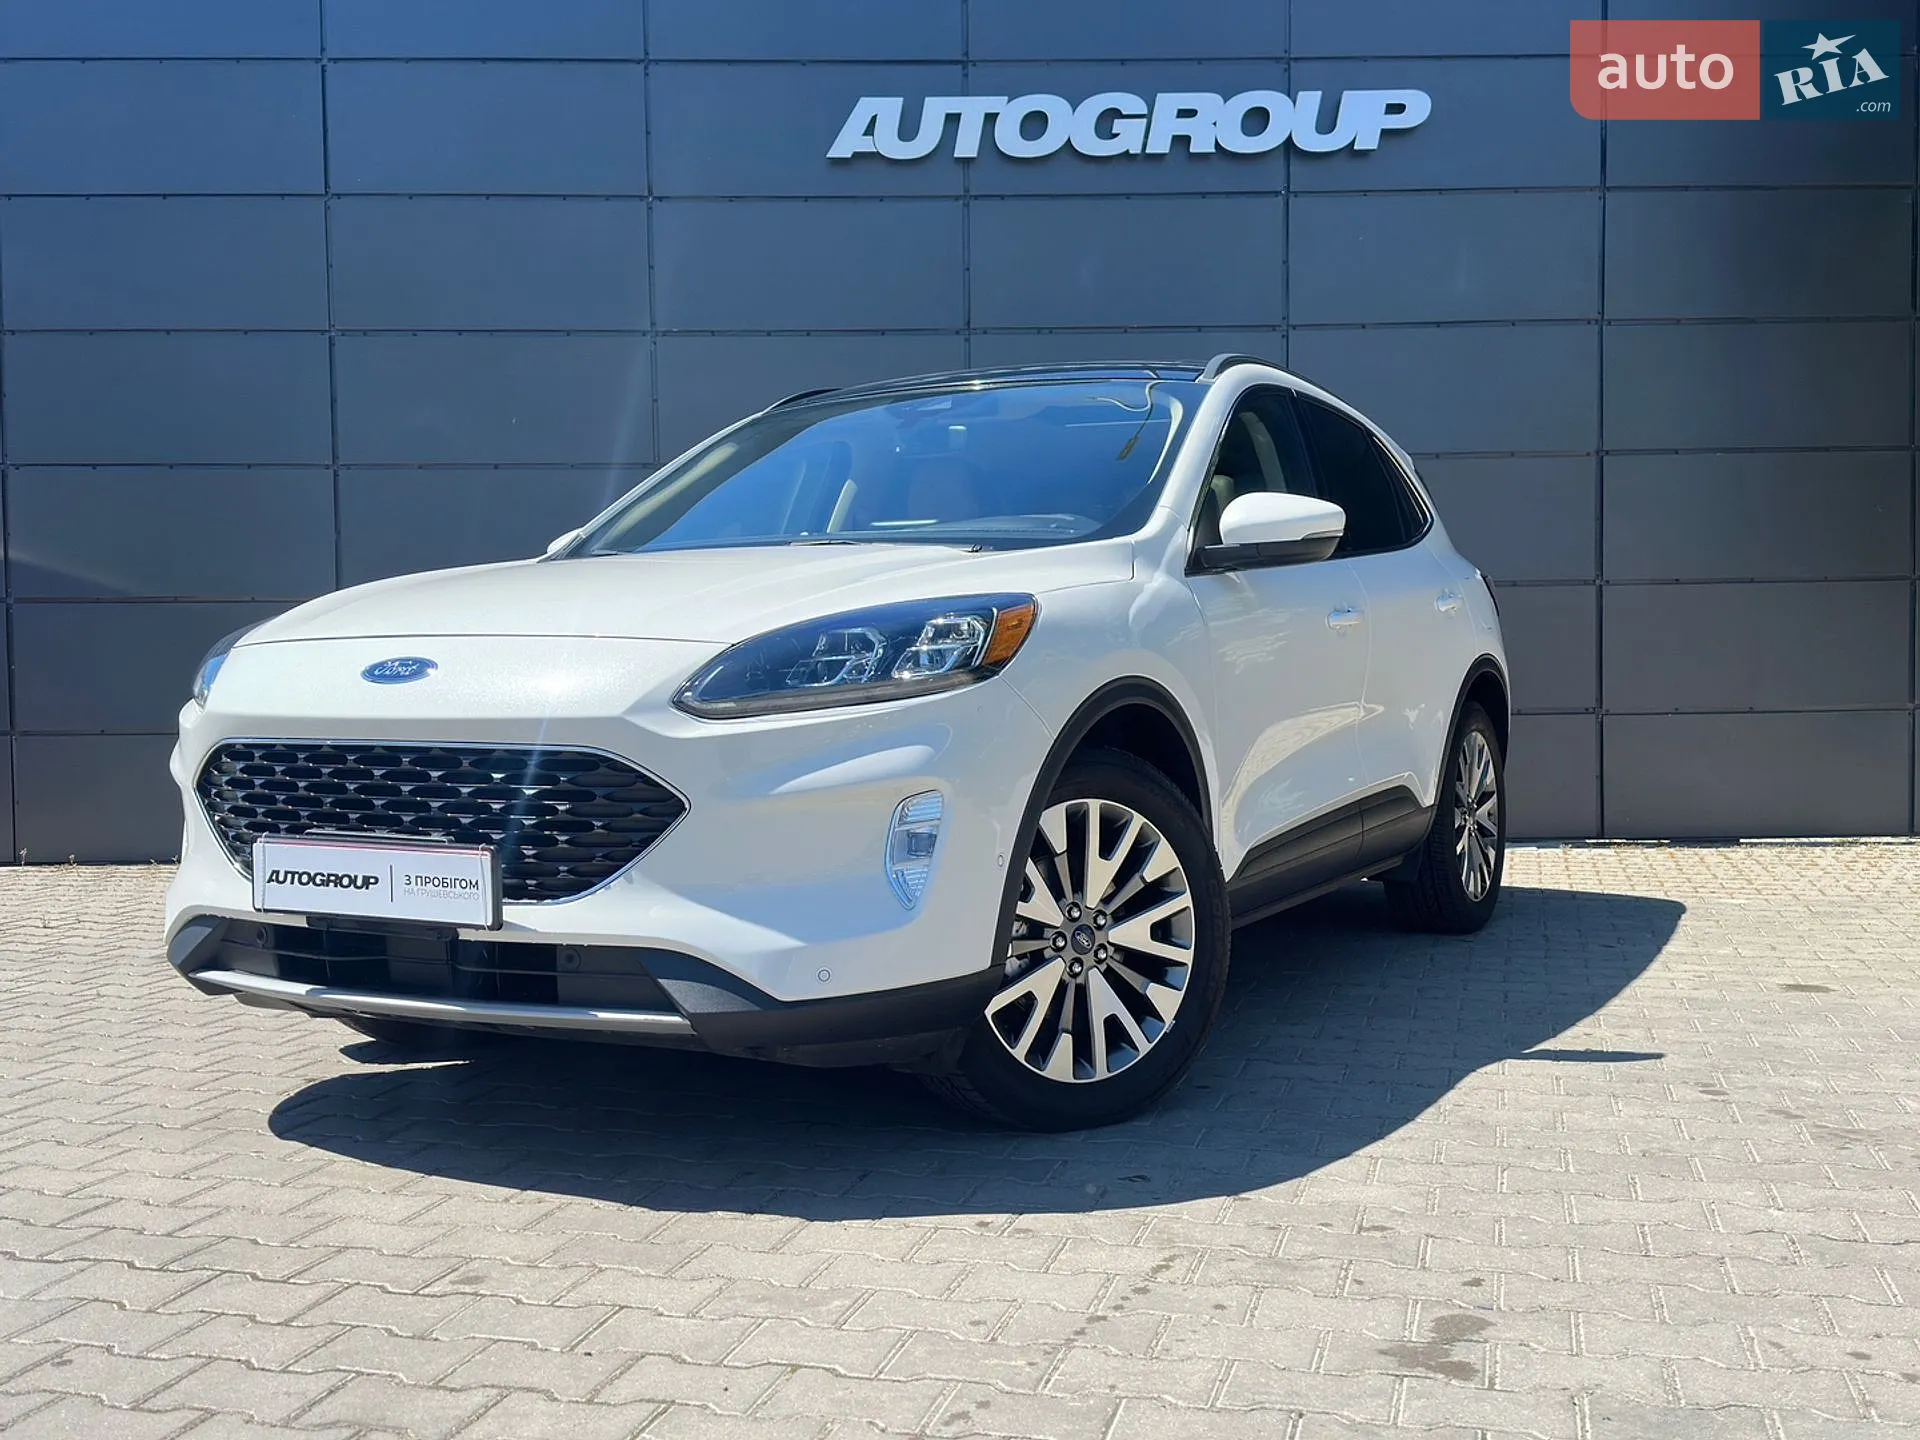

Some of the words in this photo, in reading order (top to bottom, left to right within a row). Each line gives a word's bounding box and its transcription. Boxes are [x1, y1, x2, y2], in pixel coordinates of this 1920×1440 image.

[826, 89, 1432, 160] AUTOGROUP
[373, 660, 420, 677] Ford
[266, 869, 380, 890] AUTOGROUP
[414, 875, 479, 891] ПРОБІГОМ
